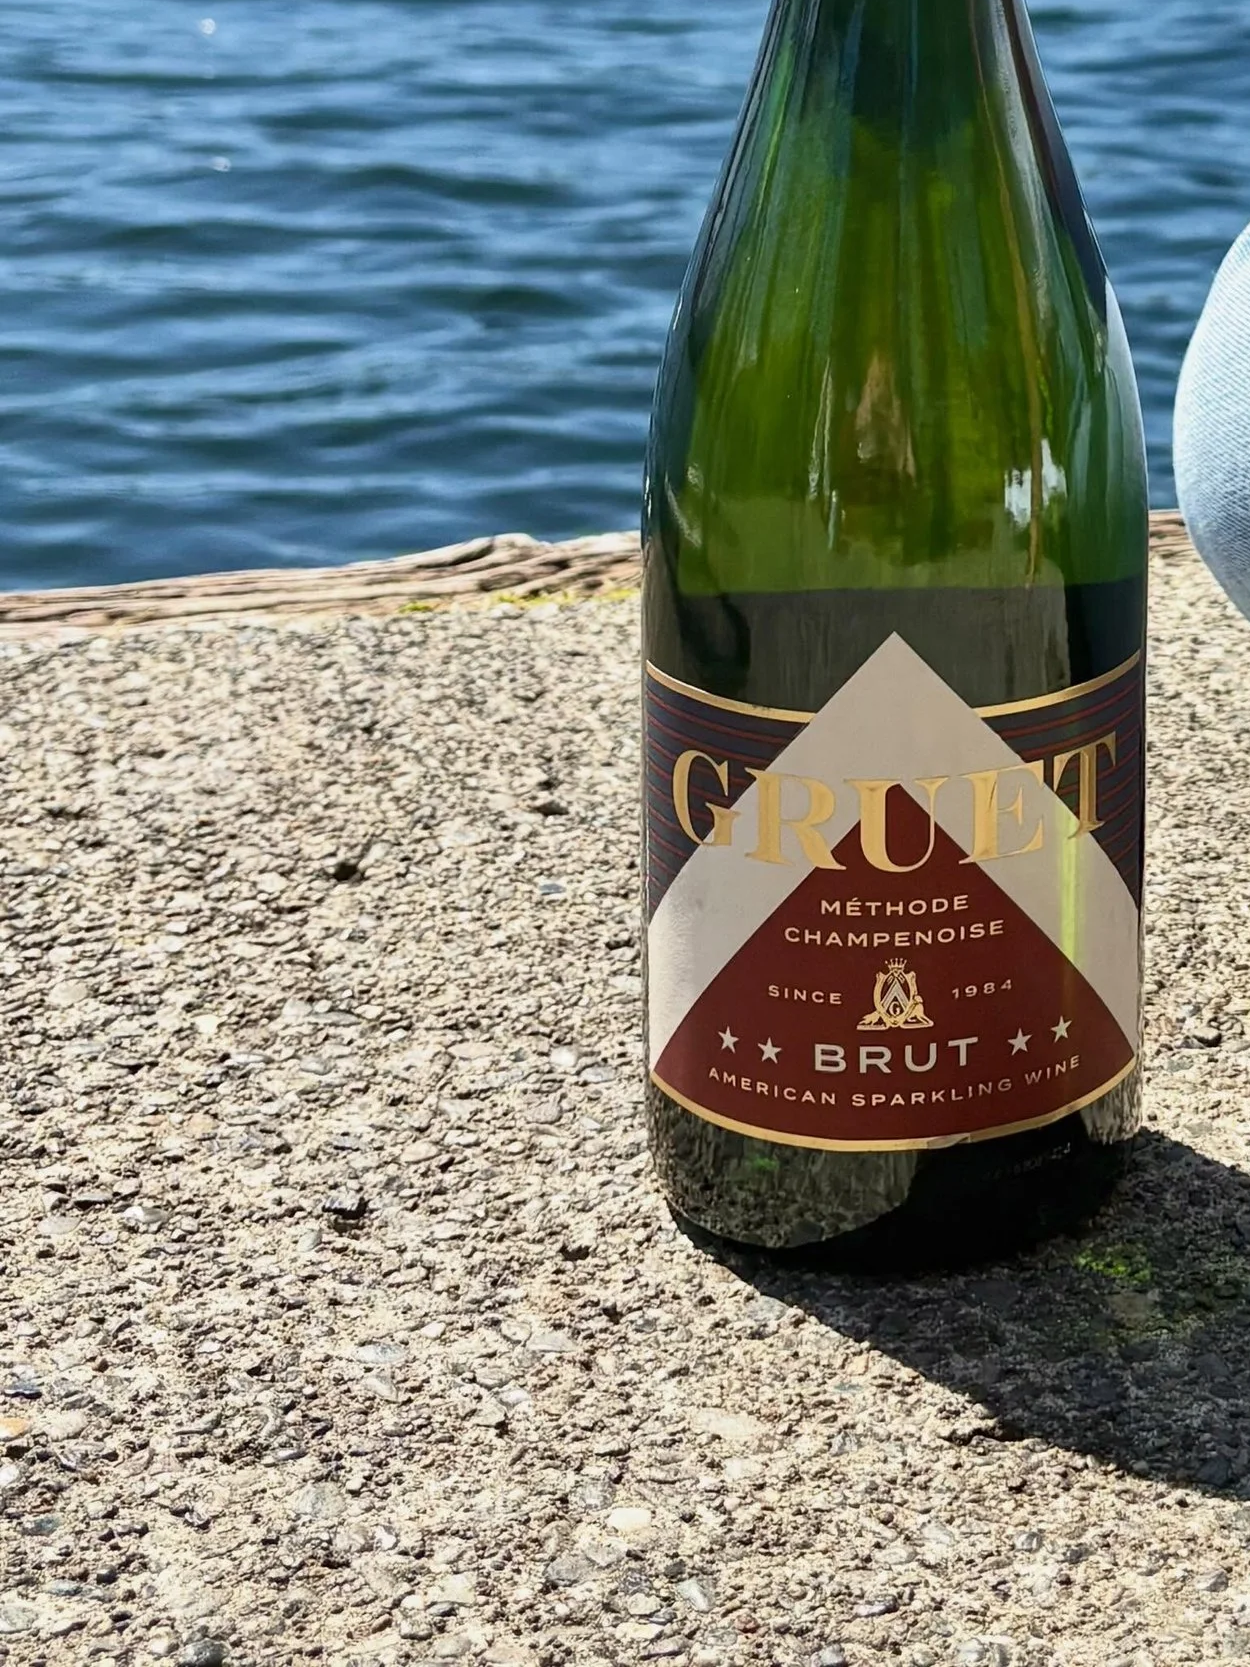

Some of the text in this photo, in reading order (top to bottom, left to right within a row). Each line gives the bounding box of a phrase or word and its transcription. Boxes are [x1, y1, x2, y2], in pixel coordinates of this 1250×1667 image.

[672, 731, 1118, 873] GRUET
[820, 894, 970, 918] MÉTHODE
[784, 919, 1005, 948] CHAMPENOISE
[767, 977, 1014, 1005] SINCE 1984
[814, 1036, 980, 1074] BRUT
[708, 1054, 1082, 1108] AMERICAN SPARKLING WINE
